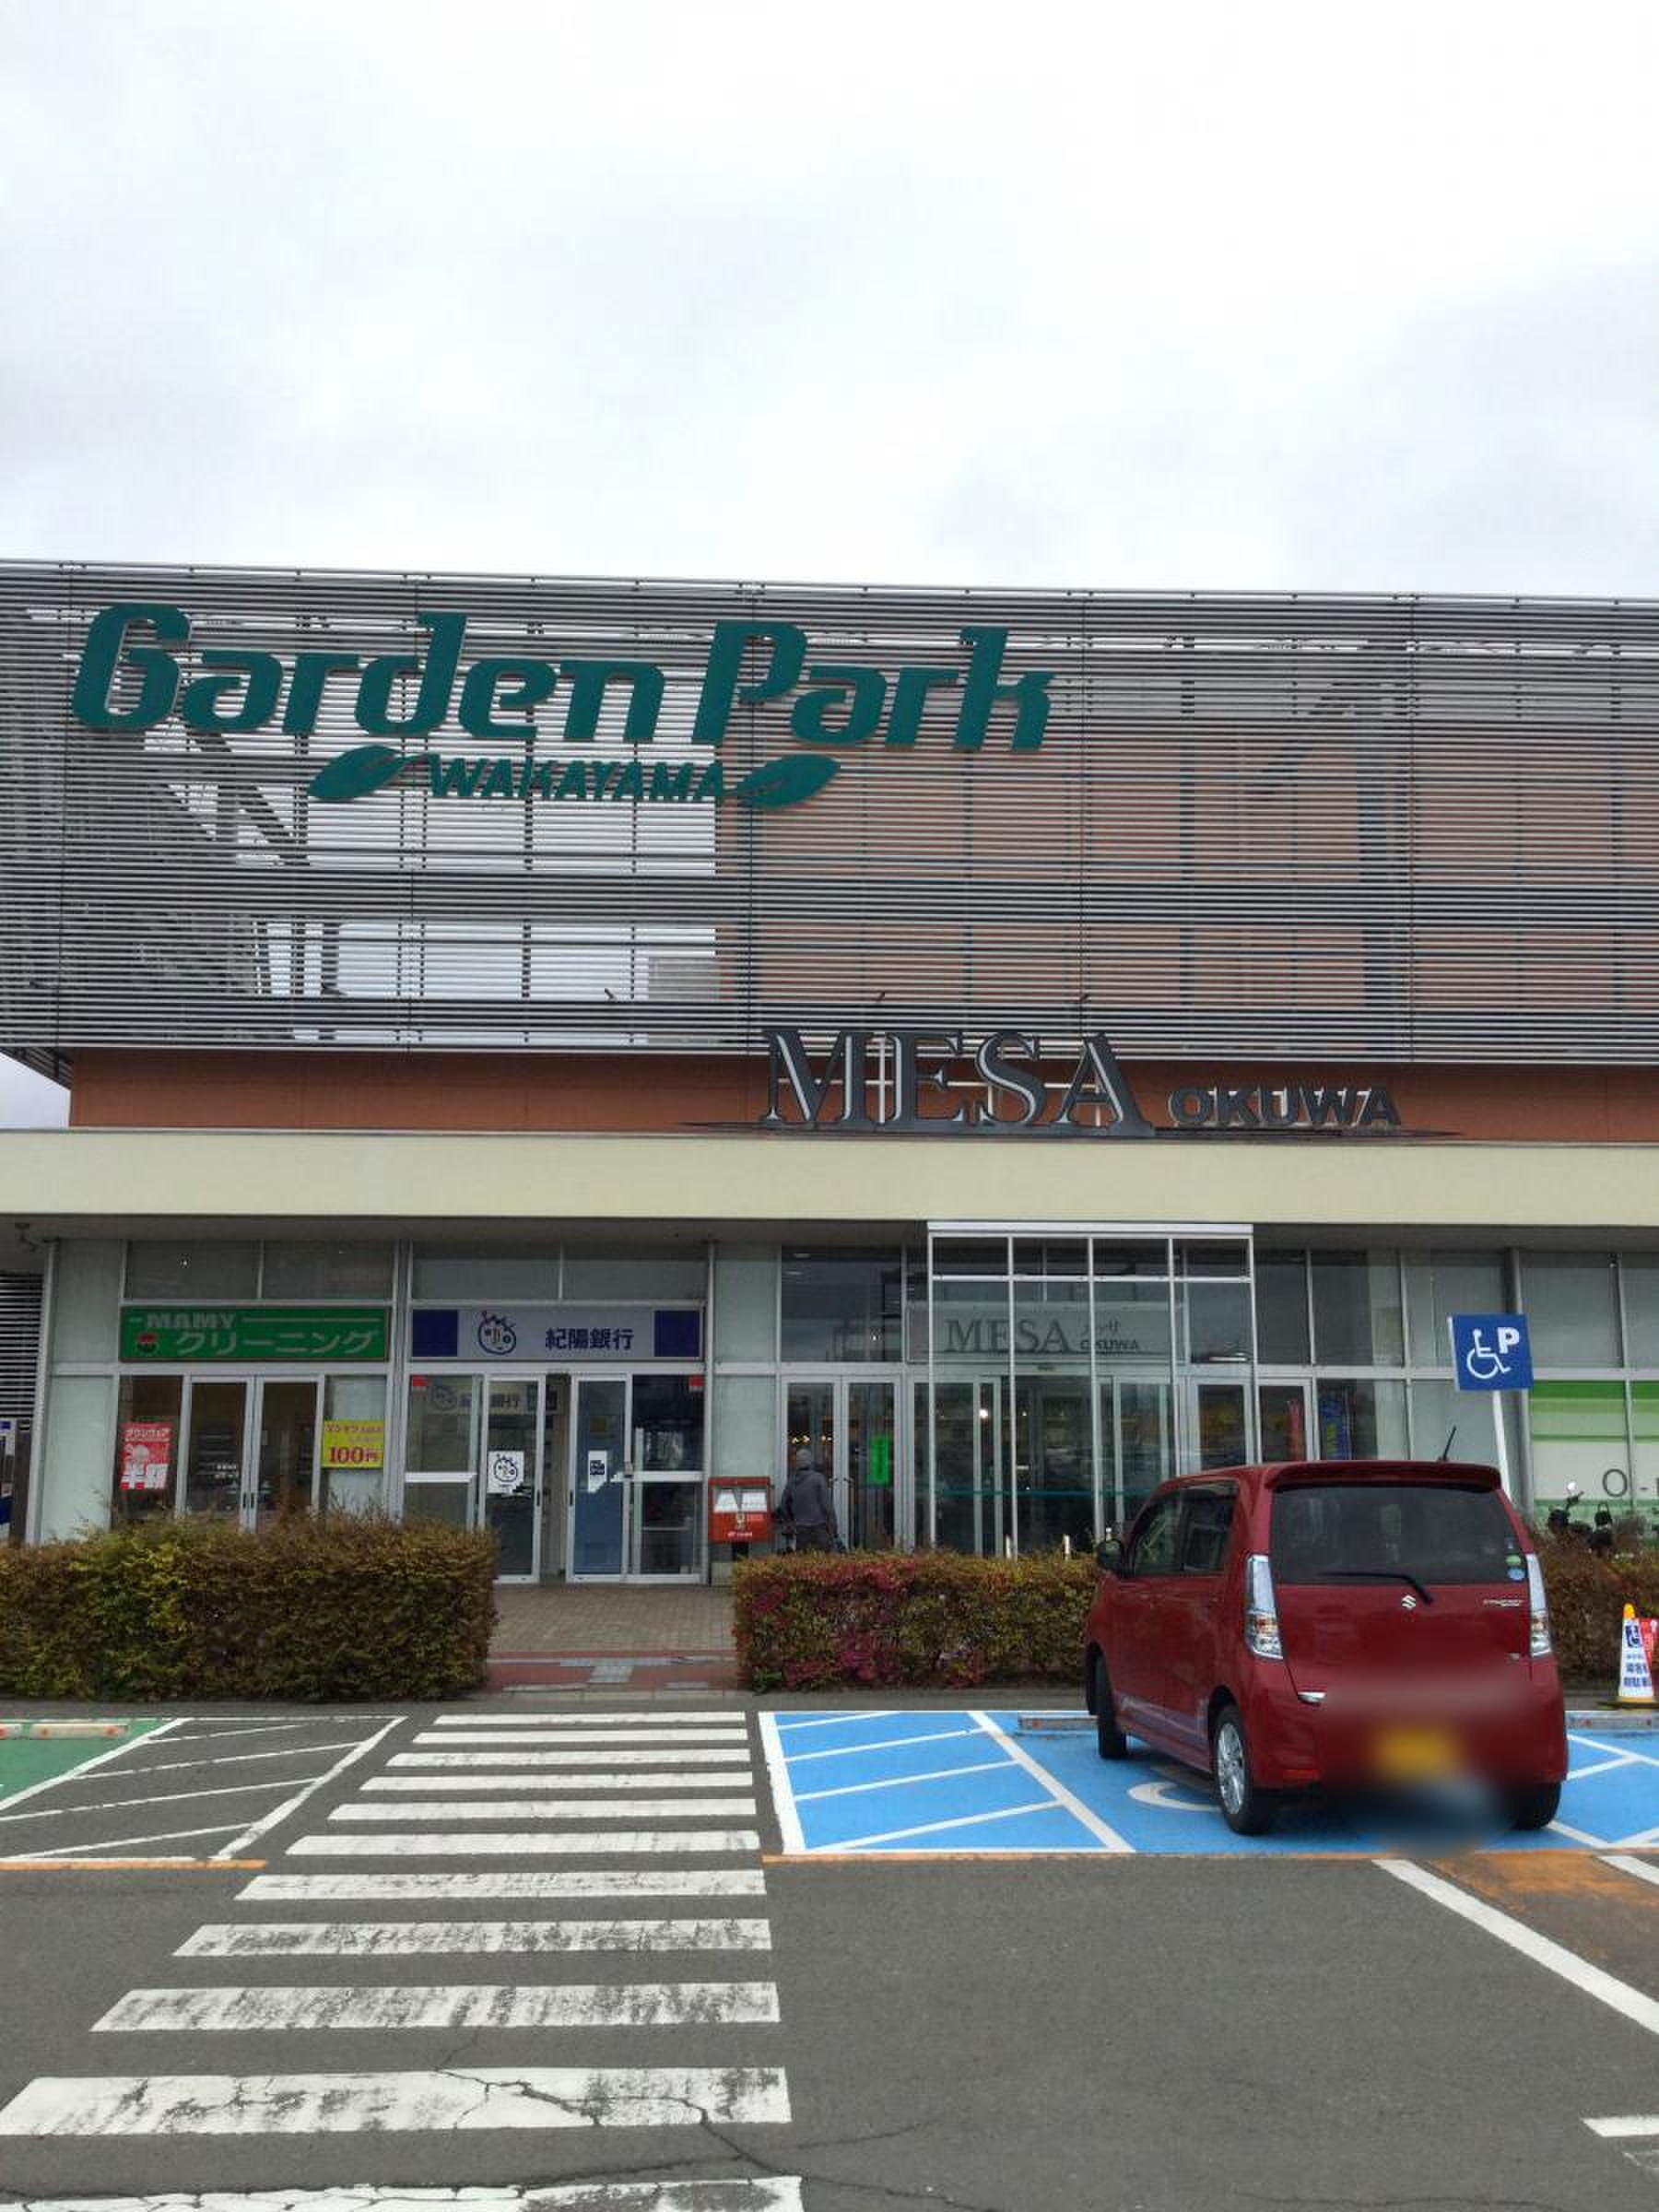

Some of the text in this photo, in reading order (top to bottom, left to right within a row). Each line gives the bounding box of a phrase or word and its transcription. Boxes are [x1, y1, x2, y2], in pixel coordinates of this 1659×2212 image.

[72, 603, 1056, 752] Garden Park
[428, 753, 724, 801] WAKAYAMA
[761, 1028, 1403, 1135] MESA OKUWA
[146, 1312, 237, 1329] MAMY
[944, 1318, 1073, 1353] MESA
[175, 1330, 380, 1356] クリーニング
[545, 1327, 635, 1350] 紀陽銀行
[1497, 1327, 1520, 1353] P
